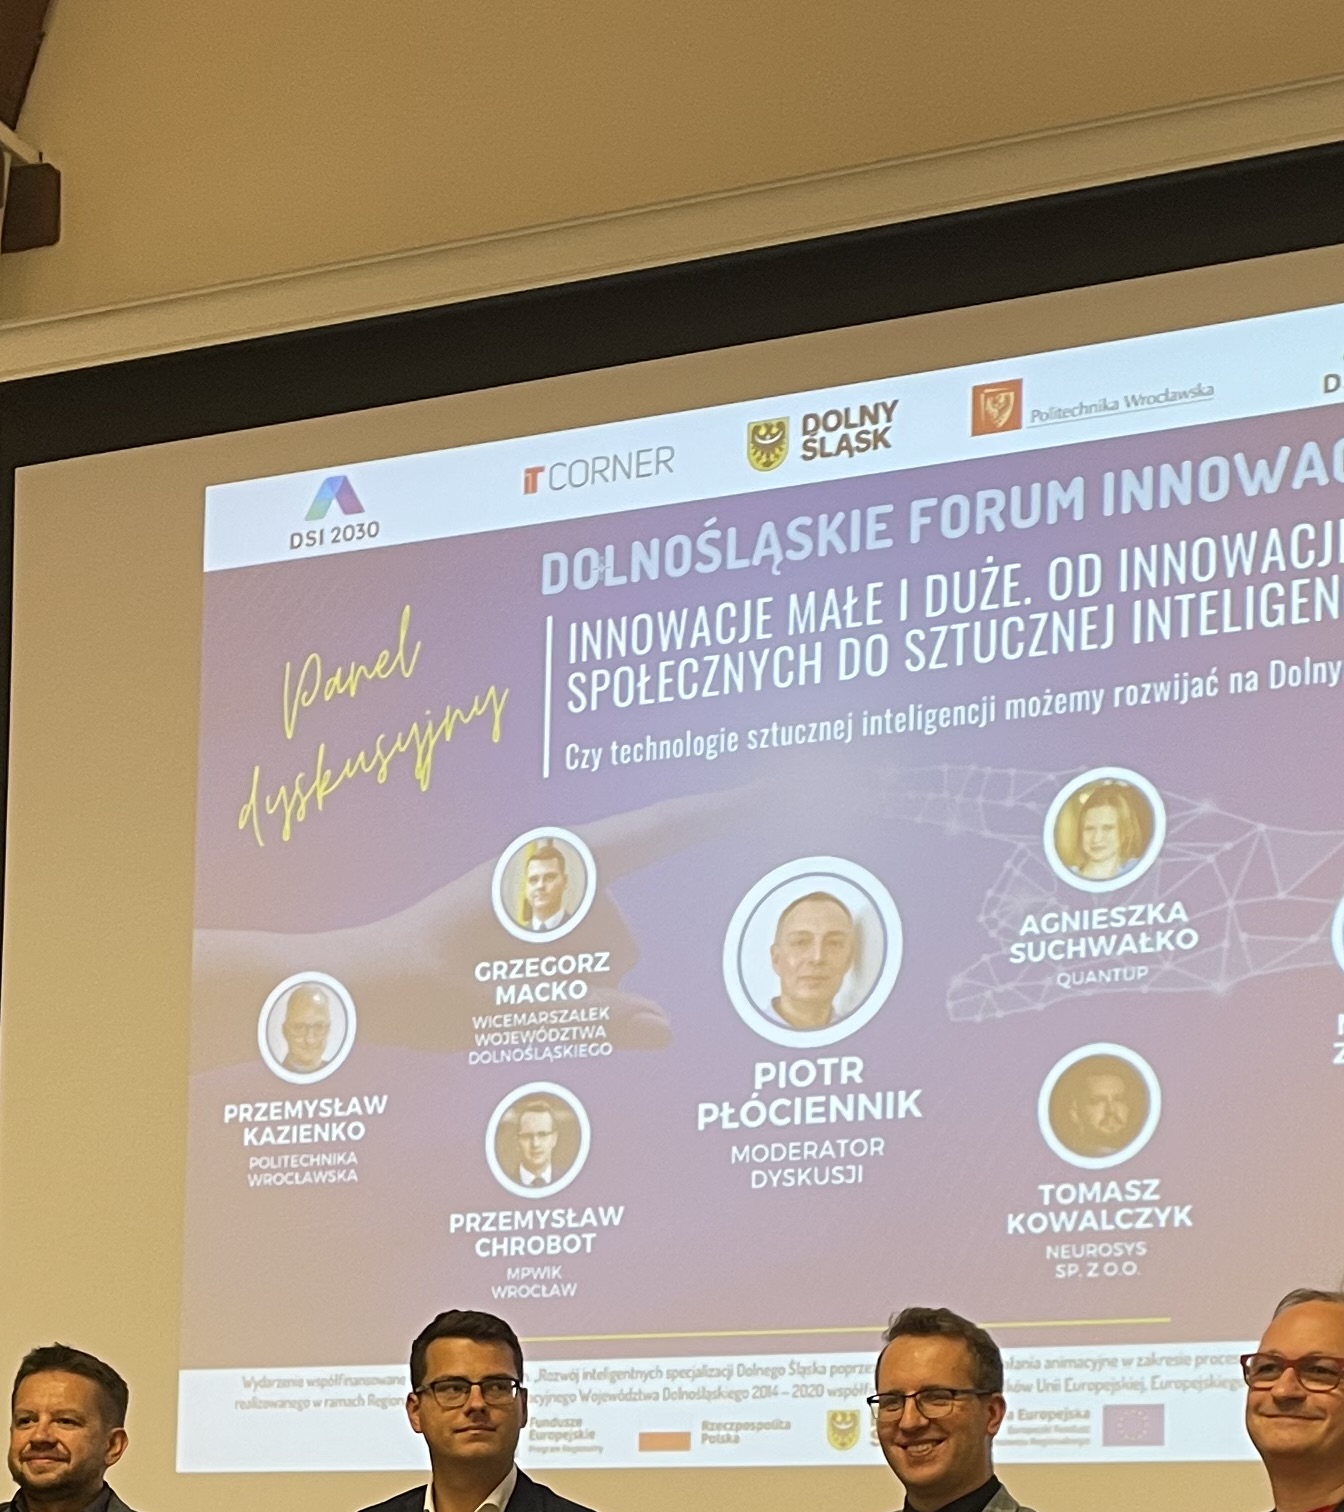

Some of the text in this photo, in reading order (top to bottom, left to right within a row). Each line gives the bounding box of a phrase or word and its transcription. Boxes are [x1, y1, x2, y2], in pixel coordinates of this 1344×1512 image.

[1030, 382, 1214, 423] Politechnika Wrocławska
[801, 400, 899, 435] DOLNY
[801, 424, 892, 462] ŚLĄSK
[549, 446, 675, 492] CORNER
[289, 521, 380, 550] DSI 2030
[541, 502, 893, 596] DOLNOŚLĄSKIE
[908, 476, 1085, 544] FORUM
[570, 596, 773, 663] INNOWACJE
[788, 580, 884, 635] MAŁE
[900, 579, 908, 620] I
[924, 555, 1032, 615] DUŻE.
[1048, 553, 1101, 602] OD
[280, 605, 421, 739] Panel
[567, 642, 821, 713] SPOŁECZNYCH
[839, 633, 888, 681] DO
[905, 603, 1115, 673] SZTUCZNEJ
[565, 742, 602, 774] Czy
[610, 728, 739, 767] technologie
[748, 713, 854, 755] sztucznej
[861, 695, 996, 737] inteligencji
[1005, 685, 1105, 720] możemy
[1113, 667, 1218, 708] rozwijać
[1229, 670, 1258, 694] na
[239, 683, 508, 846] dyskusyjny
[1019, 901, 1189, 936] AGNIESZKA
[1008, 928, 1199, 965] SUCHWAŁKO
[474, 952, 610, 981] GRZEGORZ
[1056, 966, 1149, 989] QUANTUP
[495, 979, 587, 1005] MACKO
[473, 1006, 610, 1029] WICEMARSZAŁEK
[475, 1023, 607, 1047] WOJEWÓDZTWA
[469, 1041, 613, 1064] DOLNOŚLĄSKIEGO
[754, 1056, 864, 1089] PIOTR
[223, 1094, 388, 1123] PRZEMYSŁAW
[697, 1089, 923, 1131] PŁÓCIENNIK
[243, 1121, 366, 1146] KAZIENKO
[249, 1151, 358, 1170] POLITECHNIKA
[731, 1138, 885, 1163] MODERATOR
[248, 1169, 358, 1186] WROCŁAWSKA
[751, 1164, 863, 1189] DYSKUSJI
[1038, 1179, 1161, 1206] TOMASZ
[449, 1205, 625, 1233] PRZEMYSŁAW
[1006, 1205, 1193, 1235] KOWALCZYK
[475, 1232, 596, 1257] CHROBOT
[1045, 1242, 1147, 1259] NEUROSYS
[506, 1265, 562, 1281] MPWIK
[1055, 1263, 1083, 1278] SP.
[1086, 1262, 1099, 1277] Z
[491, 1282, 577, 1299] WROCŁAW
[737, 1362, 786, 1379] Dolnego
[788, 1359, 827, 1378] Śląska
[792, 1384, 824, 1398] 2020
